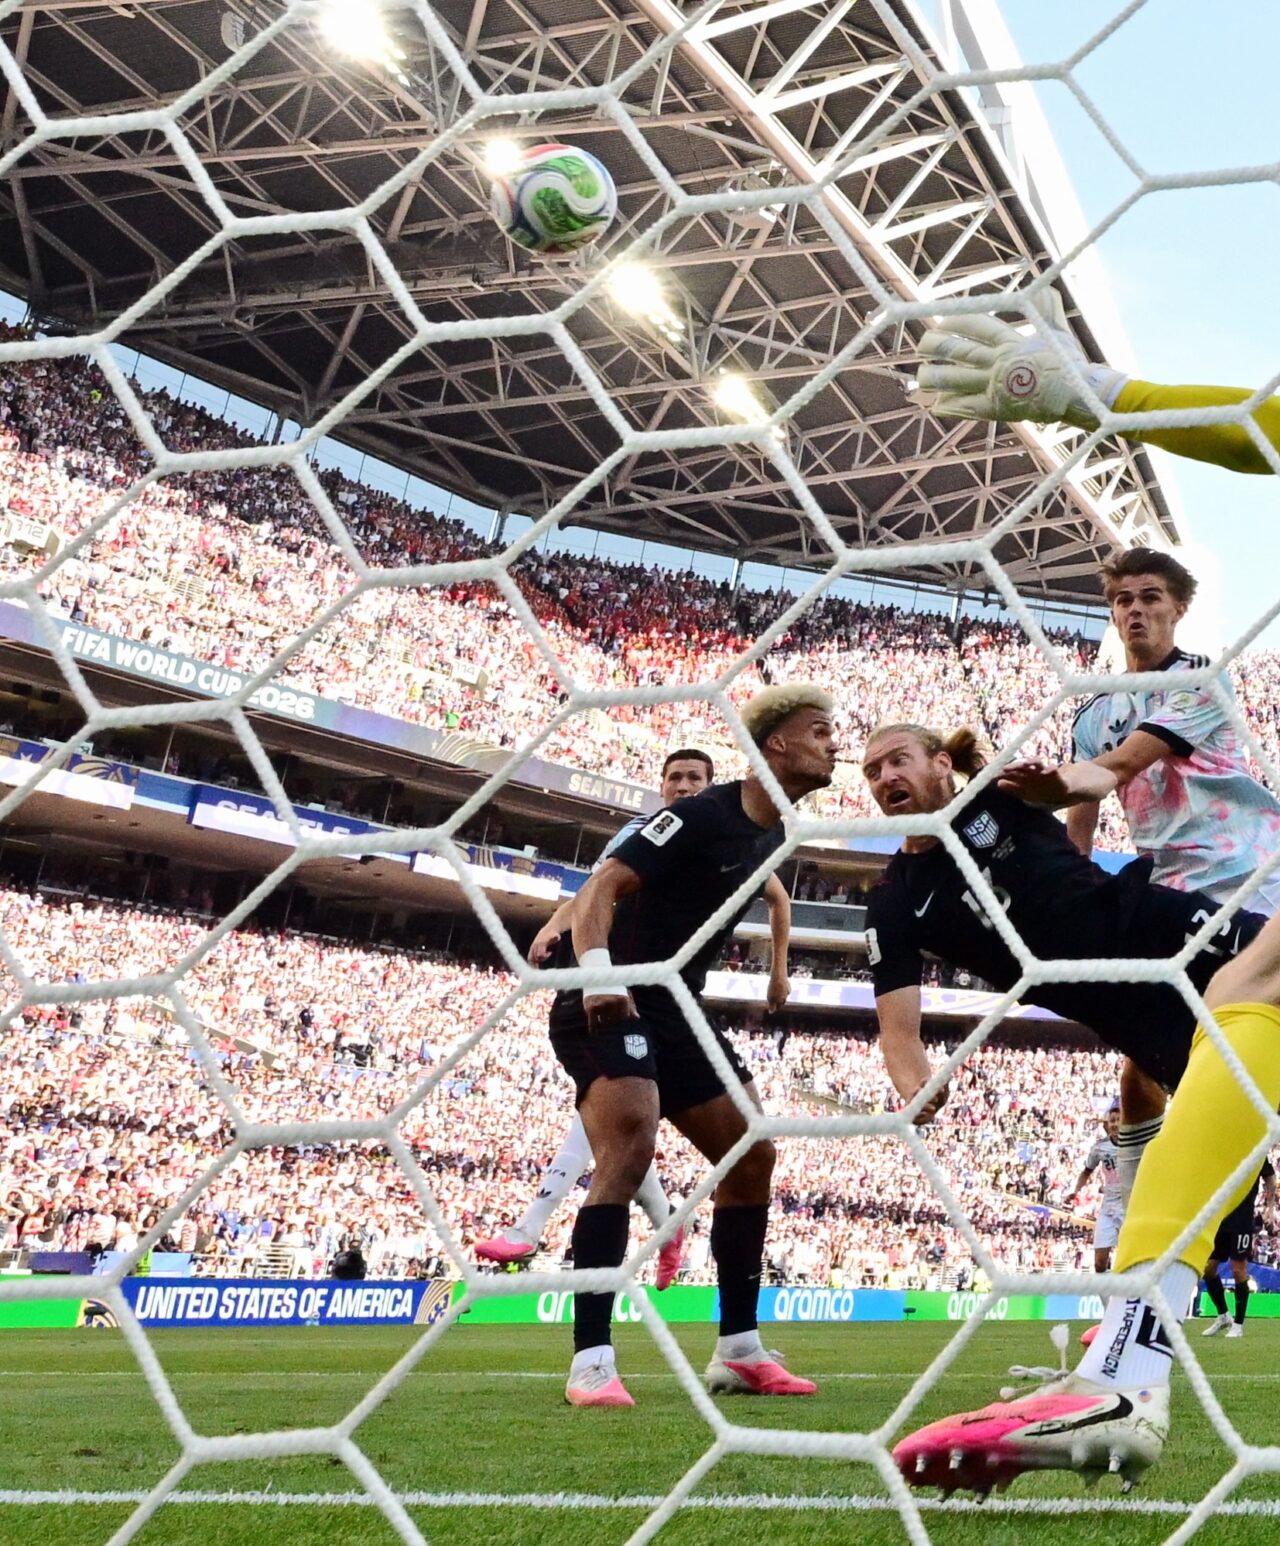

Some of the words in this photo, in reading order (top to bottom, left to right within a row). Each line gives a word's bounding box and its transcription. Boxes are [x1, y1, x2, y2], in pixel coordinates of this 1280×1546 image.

[60, 626, 111, 662] FIFA
[116, 641, 196, 685] WORLD
[198, 667, 242, 697] CUP
[568, 773, 644, 808] SEATTLE
[1237, 1234, 1250, 1249] 10
[135, 1286, 219, 1319] UNITED
[219, 1286, 297, 1319] STATES
[299, 1287, 328, 1318] OF
[326, 1288, 413, 1318] AMERICA
[774, 1288, 853, 1320] aramco
[1100, 1302, 1137, 1380] TAPEDESIGN
